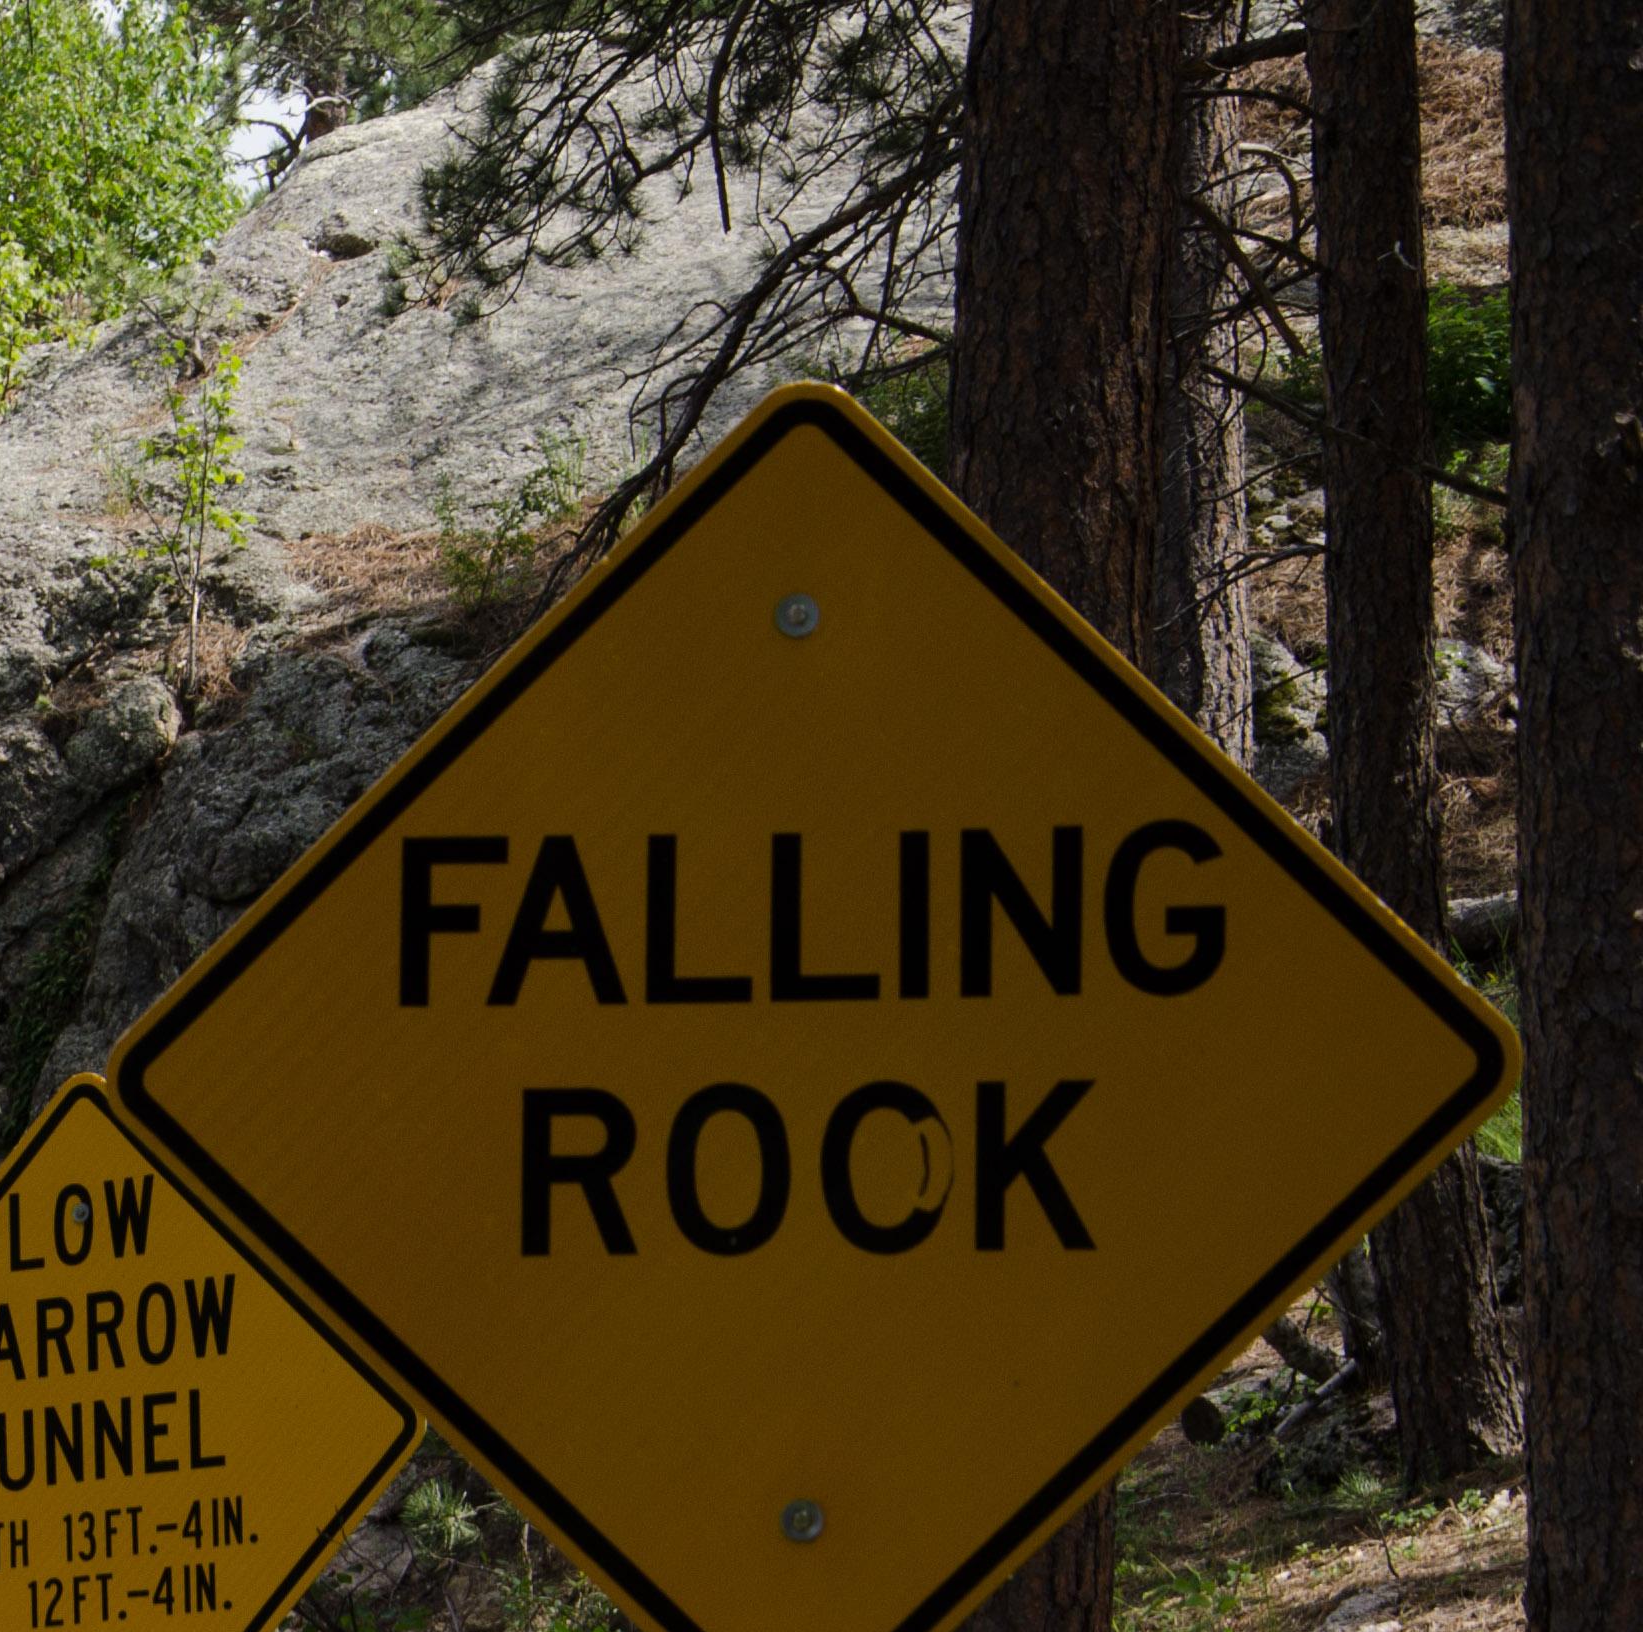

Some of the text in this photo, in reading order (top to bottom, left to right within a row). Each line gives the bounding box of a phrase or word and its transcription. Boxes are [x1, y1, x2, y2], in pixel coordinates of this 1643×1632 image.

[397, 817, 1228, 1008] FALLING
[519, 1077, 1098, 1258] ROCK
[8, 1173, 155, 1273] LOW
[62, 1495, 259, 1563] 13FT.-4IN.
[27, 1561, 233, 1630] 12FT.-4IN.
